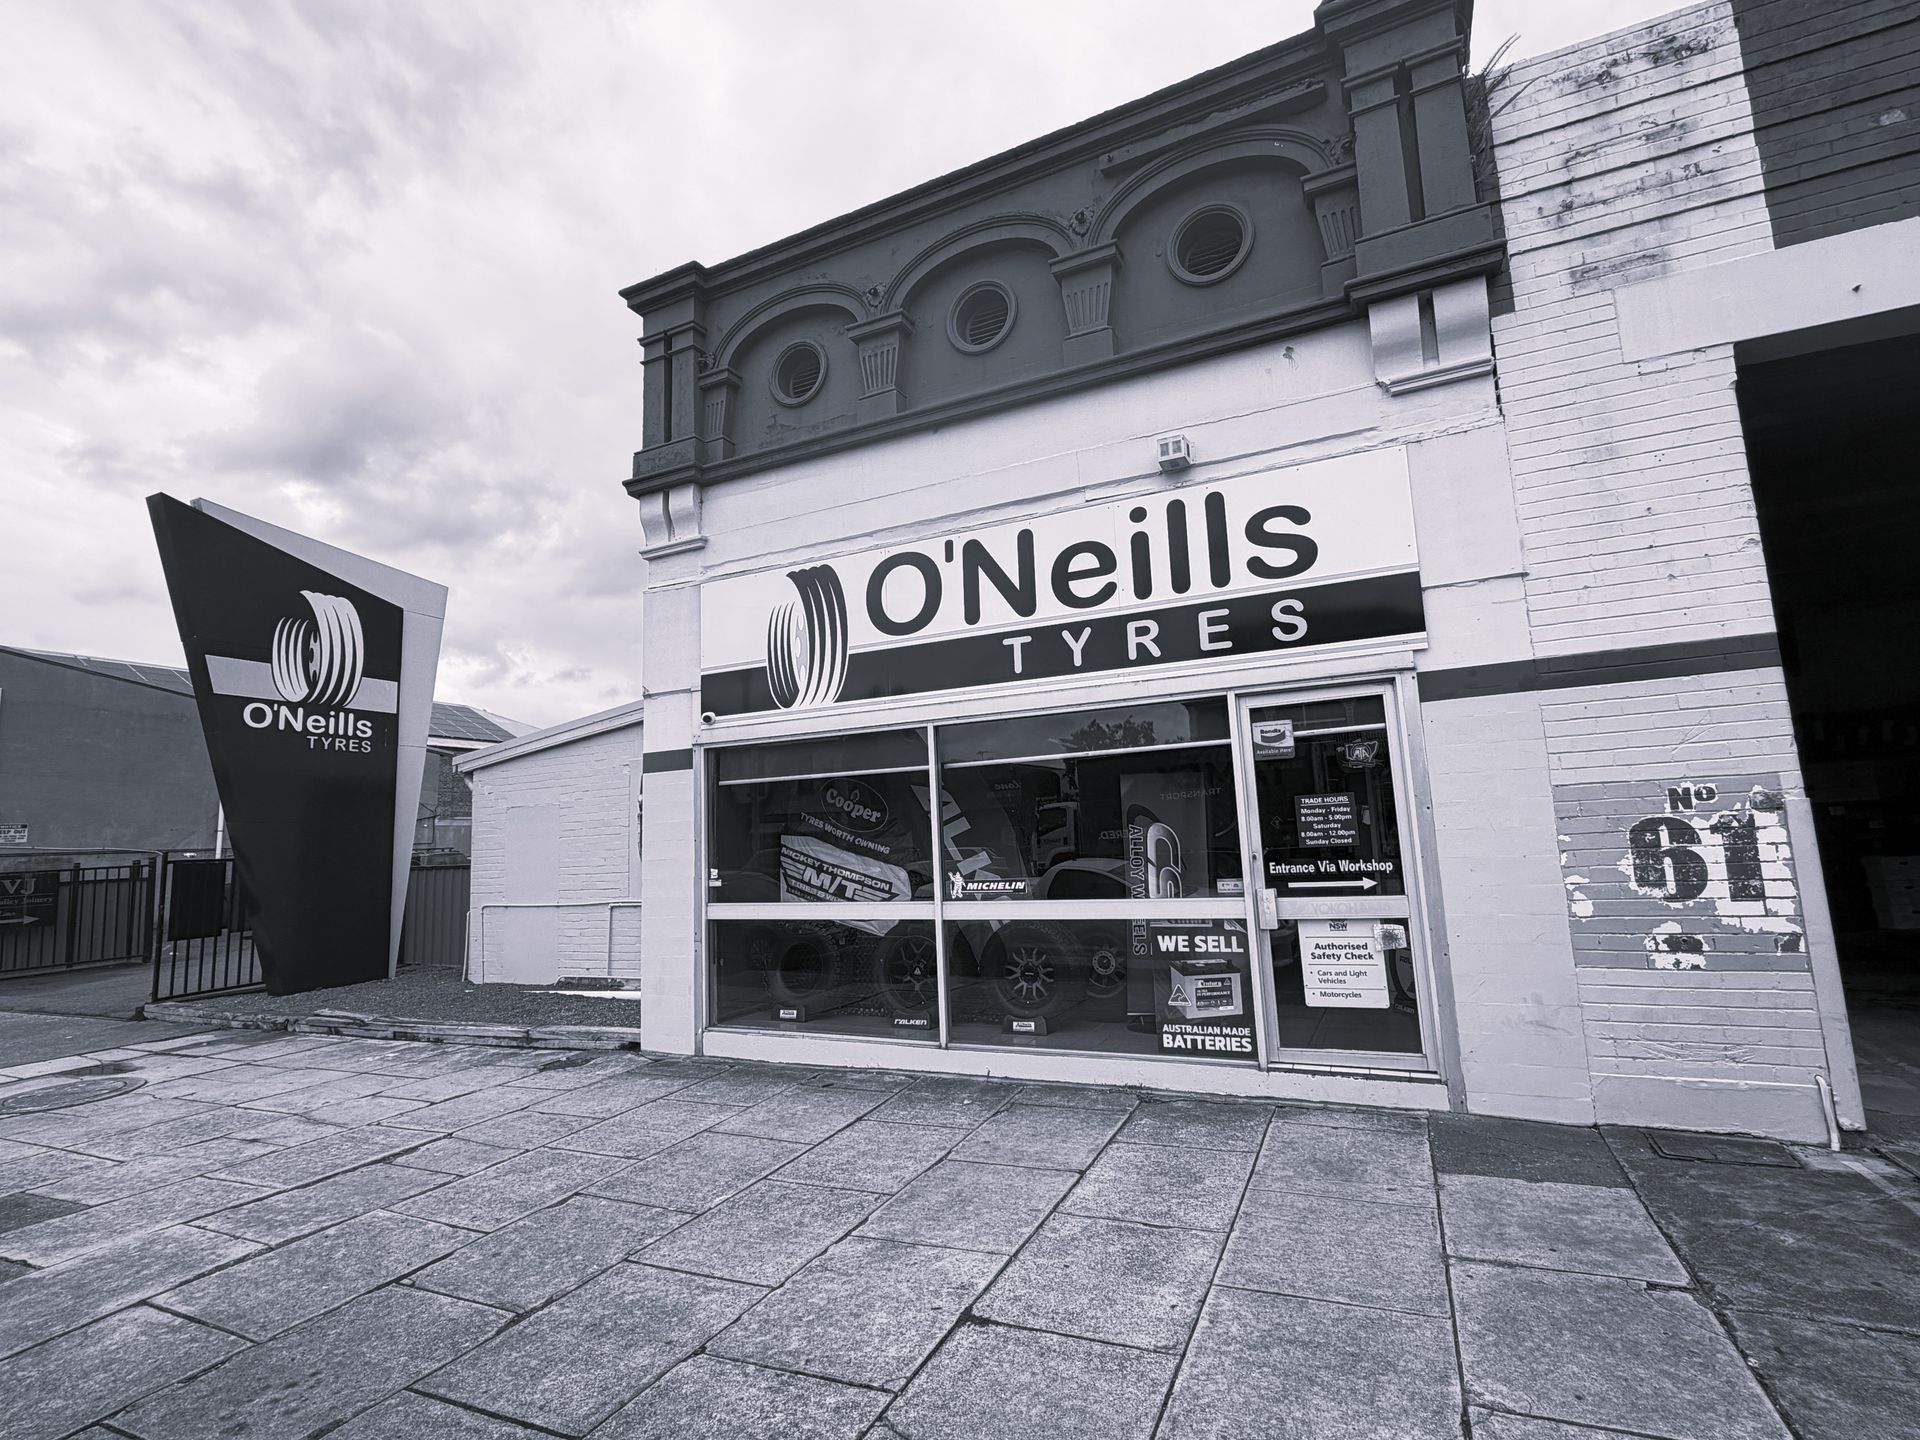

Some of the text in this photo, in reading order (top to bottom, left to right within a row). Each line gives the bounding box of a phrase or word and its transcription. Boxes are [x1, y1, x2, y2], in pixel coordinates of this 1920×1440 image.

[866, 490, 1318, 636] O'Neills
[1002, 598, 1309, 675] TYRES
[243, 702, 373, 738] O'Neills
[306, 735, 372, 753] TYRES
[826, 788, 881, 822] Cooper
[801, 812, 890, 854] TYRES WORTH OWNING
[1128, 824, 1145, 880] ALLOY
[1628, 813, 1767, 903] 61
[781, 847, 890, 891] MICKEY THOMPSON
[1269, 859, 1393, 874] Entrance Via Workshop
[966, 881, 1025, 890] MICHELIN
[1329, 922, 1348, 930] NSW
[1157, 935, 1244, 953] WE SELL
[1314, 942, 1368, 950] Authorised
[1311, 952, 1374, 962] Safety Check
[1349, 970, 1368, 979] Light
[1319, 991, 1362, 999] Motorcycles
[894, 1019, 927, 1027] FALKEN
[1162, 1023, 1251, 1036] AUSTRALIAN MADE
[1162, 1034, 1253, 1053] BATTERIES
